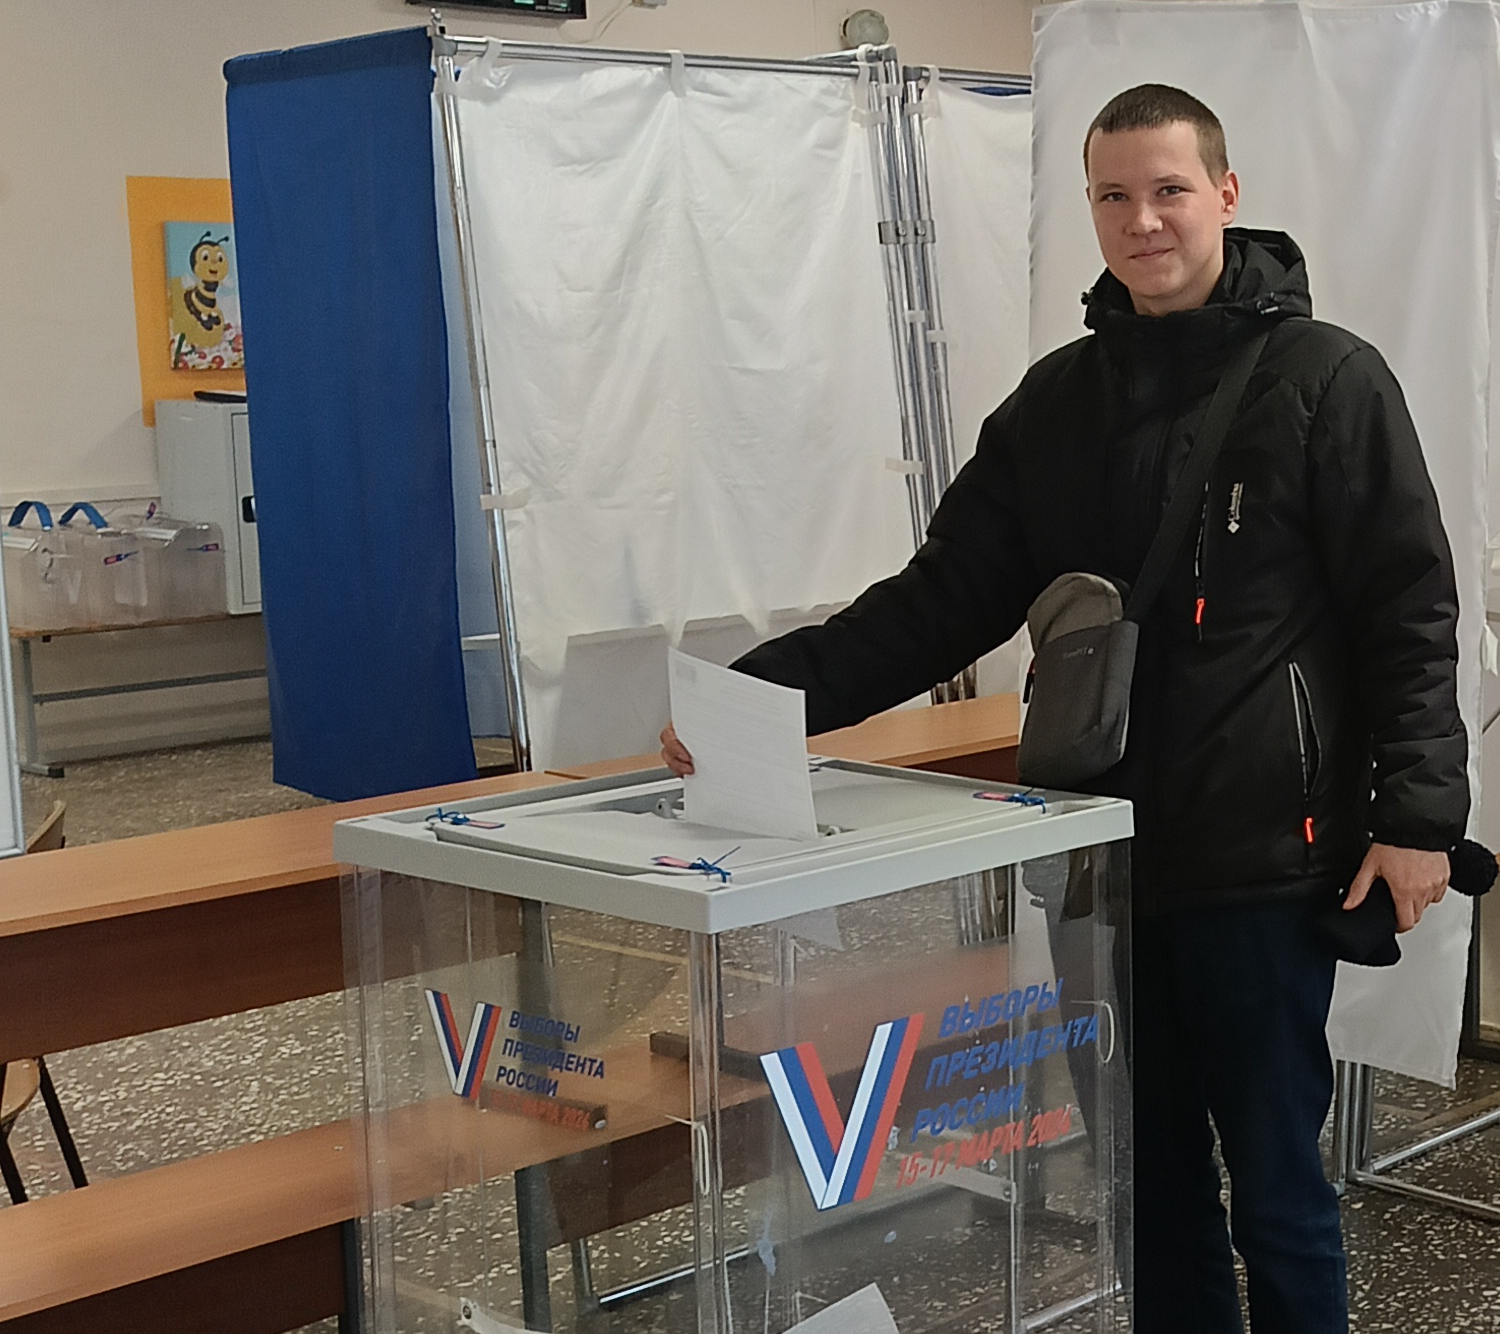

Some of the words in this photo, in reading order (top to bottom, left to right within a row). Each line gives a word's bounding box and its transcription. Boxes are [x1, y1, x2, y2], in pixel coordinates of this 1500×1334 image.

[509, 1010, 581, 1043] ВЫБОРЫ
[938, 977, 1064, 1039] ВЫБОРЫ
[496, 1065, 559, 1097] РОССИИ
[502, 1038, 604, 1078] ПРЕЗИДЕНТА
[925, 1013, 1099, 1091] ПРЕЗИДЕНТА
[910, 1082, 1025, 1144] РОССИИ
[896, 1141, 956, 1190] 15-17
[955, 1119, 1025, 1171] МАРТА
